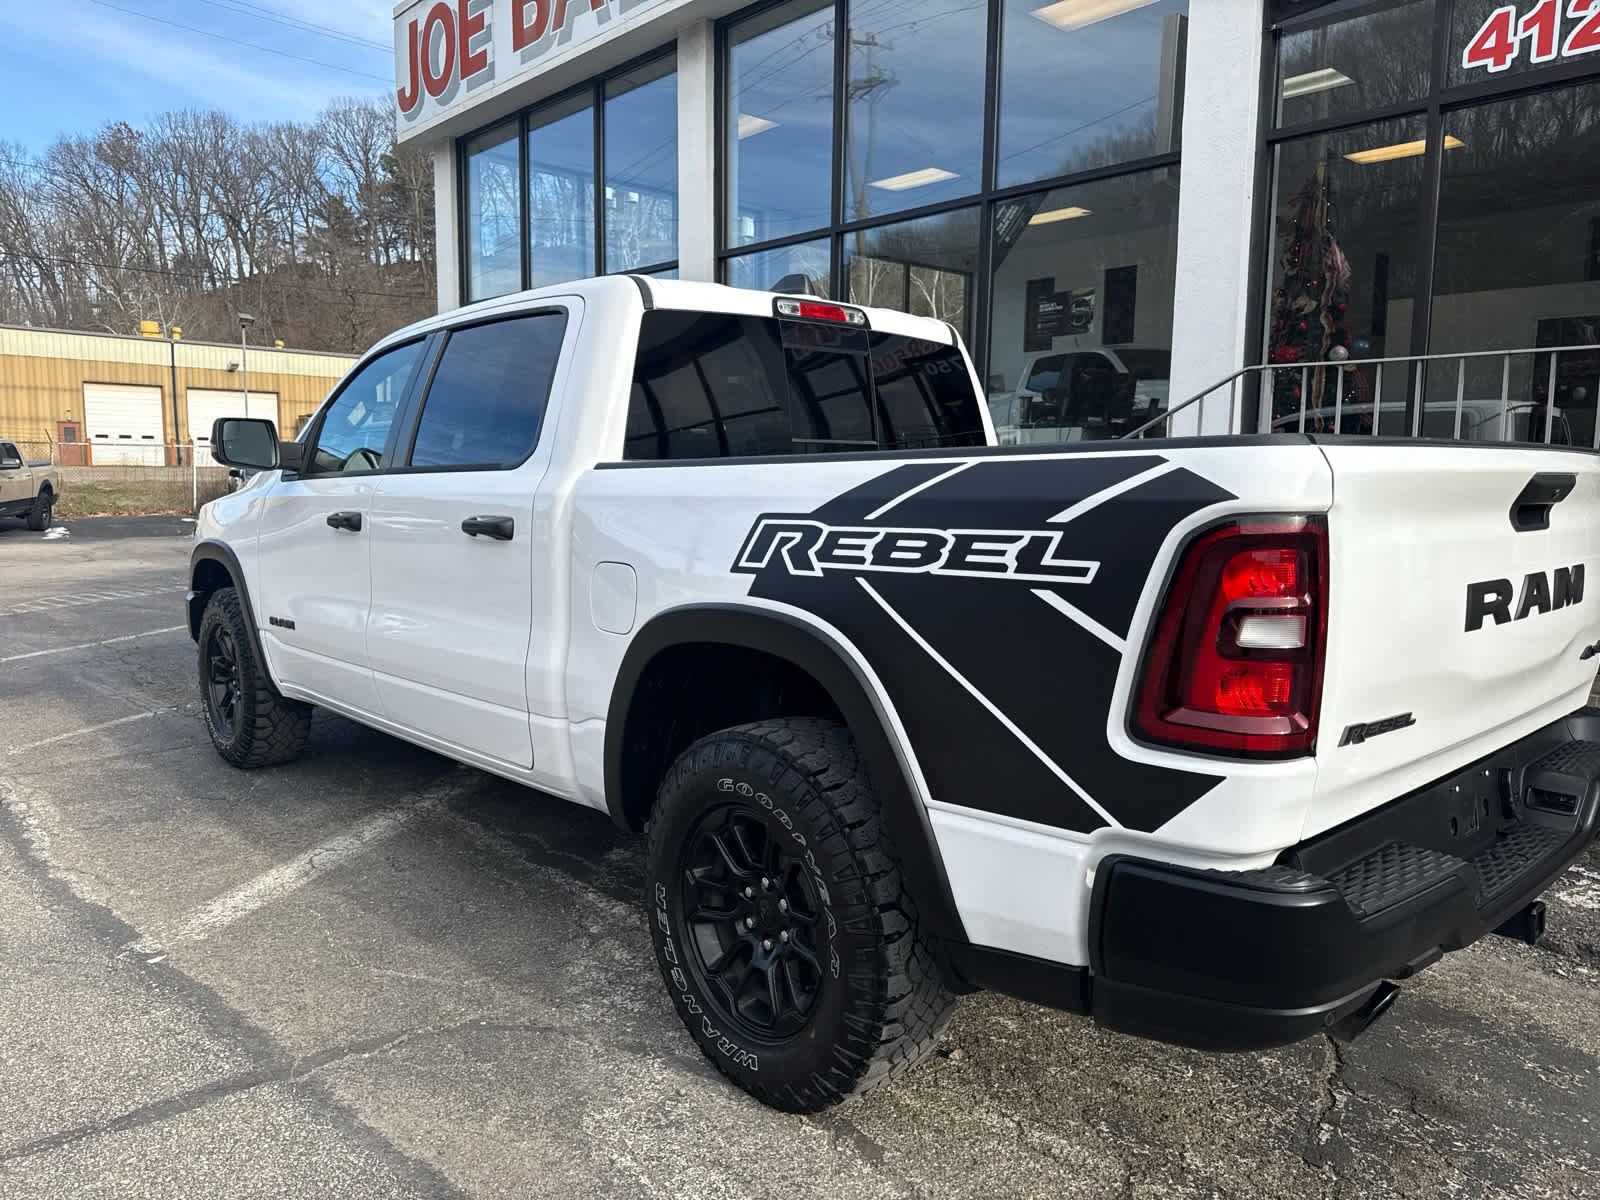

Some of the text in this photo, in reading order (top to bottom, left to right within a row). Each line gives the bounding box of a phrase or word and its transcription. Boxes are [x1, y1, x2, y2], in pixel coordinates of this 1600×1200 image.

[396, 0, 489, 114] JOE
[1462, 0, 1600, 73] 412
[737, 518, 1101, 585] REBEL
[1464, 563, 1585, 632] RAM
[1337, 711, 1417, 748] REBEL
[655, 882, 759, 1072] WRANGLER
